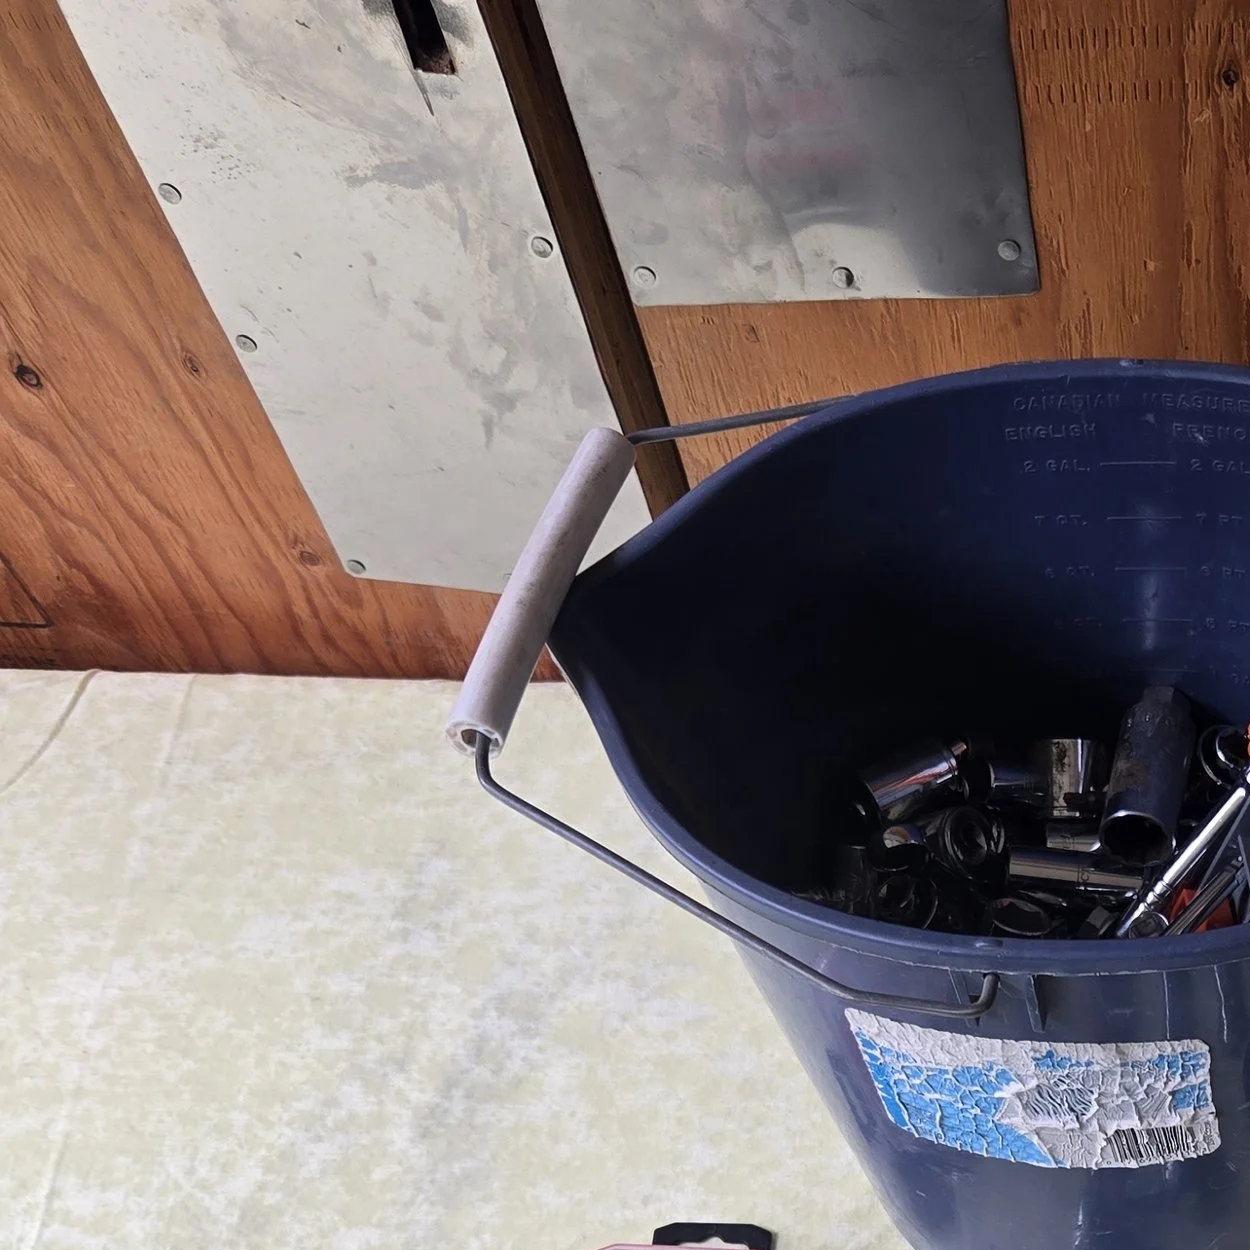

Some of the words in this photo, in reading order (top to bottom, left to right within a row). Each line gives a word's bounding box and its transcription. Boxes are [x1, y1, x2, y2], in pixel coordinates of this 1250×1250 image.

[1012, 393, 1121, 412] CANADIAN
[1004, 423, 1096, 442] ENGLISH
[1024, 460, 1037, 473] 2
[1190, 460, 1203, 472] 2
